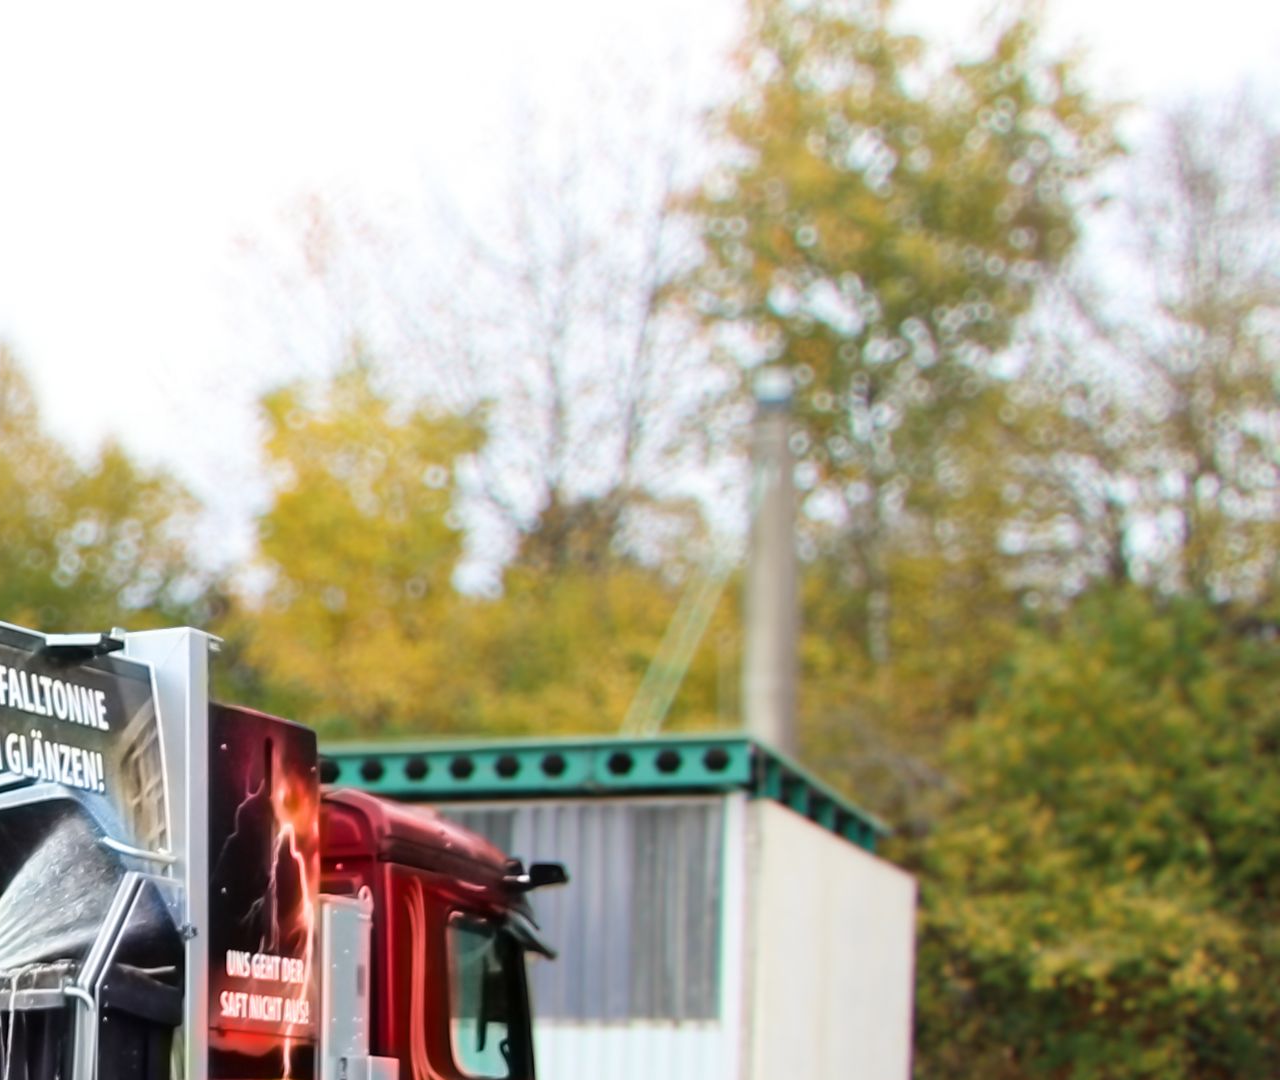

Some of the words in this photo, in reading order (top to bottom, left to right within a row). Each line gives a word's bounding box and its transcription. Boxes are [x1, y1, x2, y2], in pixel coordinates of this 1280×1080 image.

[5, 728, 106, 793] GLÄNZEN!
[226, 949, 251, 978] UNS
[252, 953, 281, 981] GEHT
[281, 957, 304, 983] DER
[220, 990, 249, 1019] SAFT
[249, 994, 283, 1022] NICHT
[283, 998, 309, 1024] AUS!
